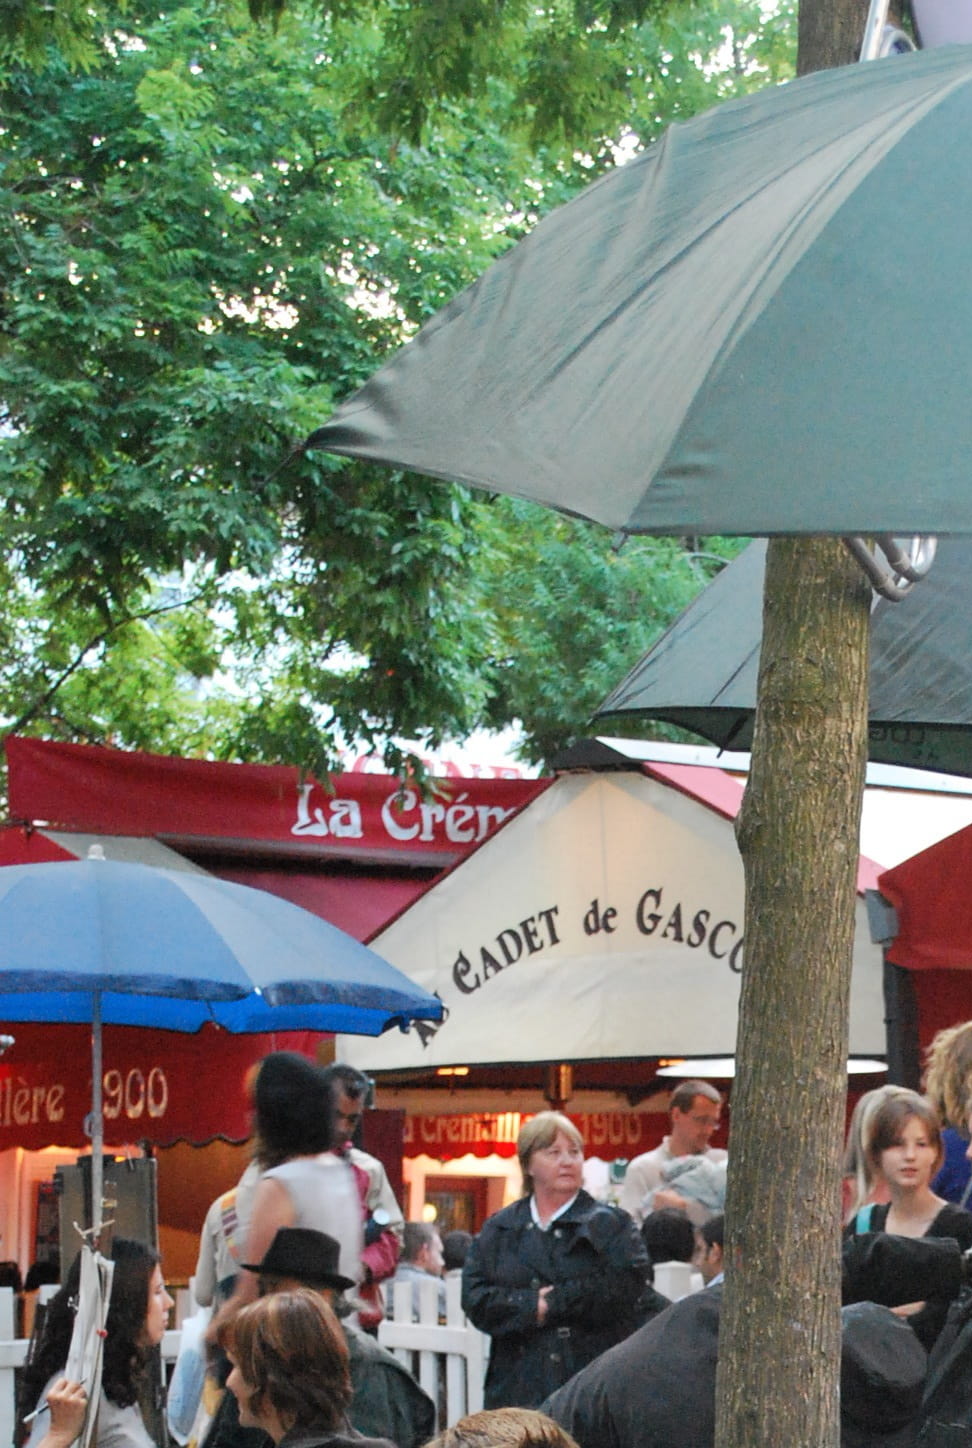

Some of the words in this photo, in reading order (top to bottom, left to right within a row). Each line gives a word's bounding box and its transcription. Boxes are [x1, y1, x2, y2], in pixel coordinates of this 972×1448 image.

[291, 784, 364, 839] La
[452, 905, 561, 994] CADET
[583, 898, 618, 936] de
[88, 1066, 169, 1119] 900
[579, 1111, 642, 1145] 1900
